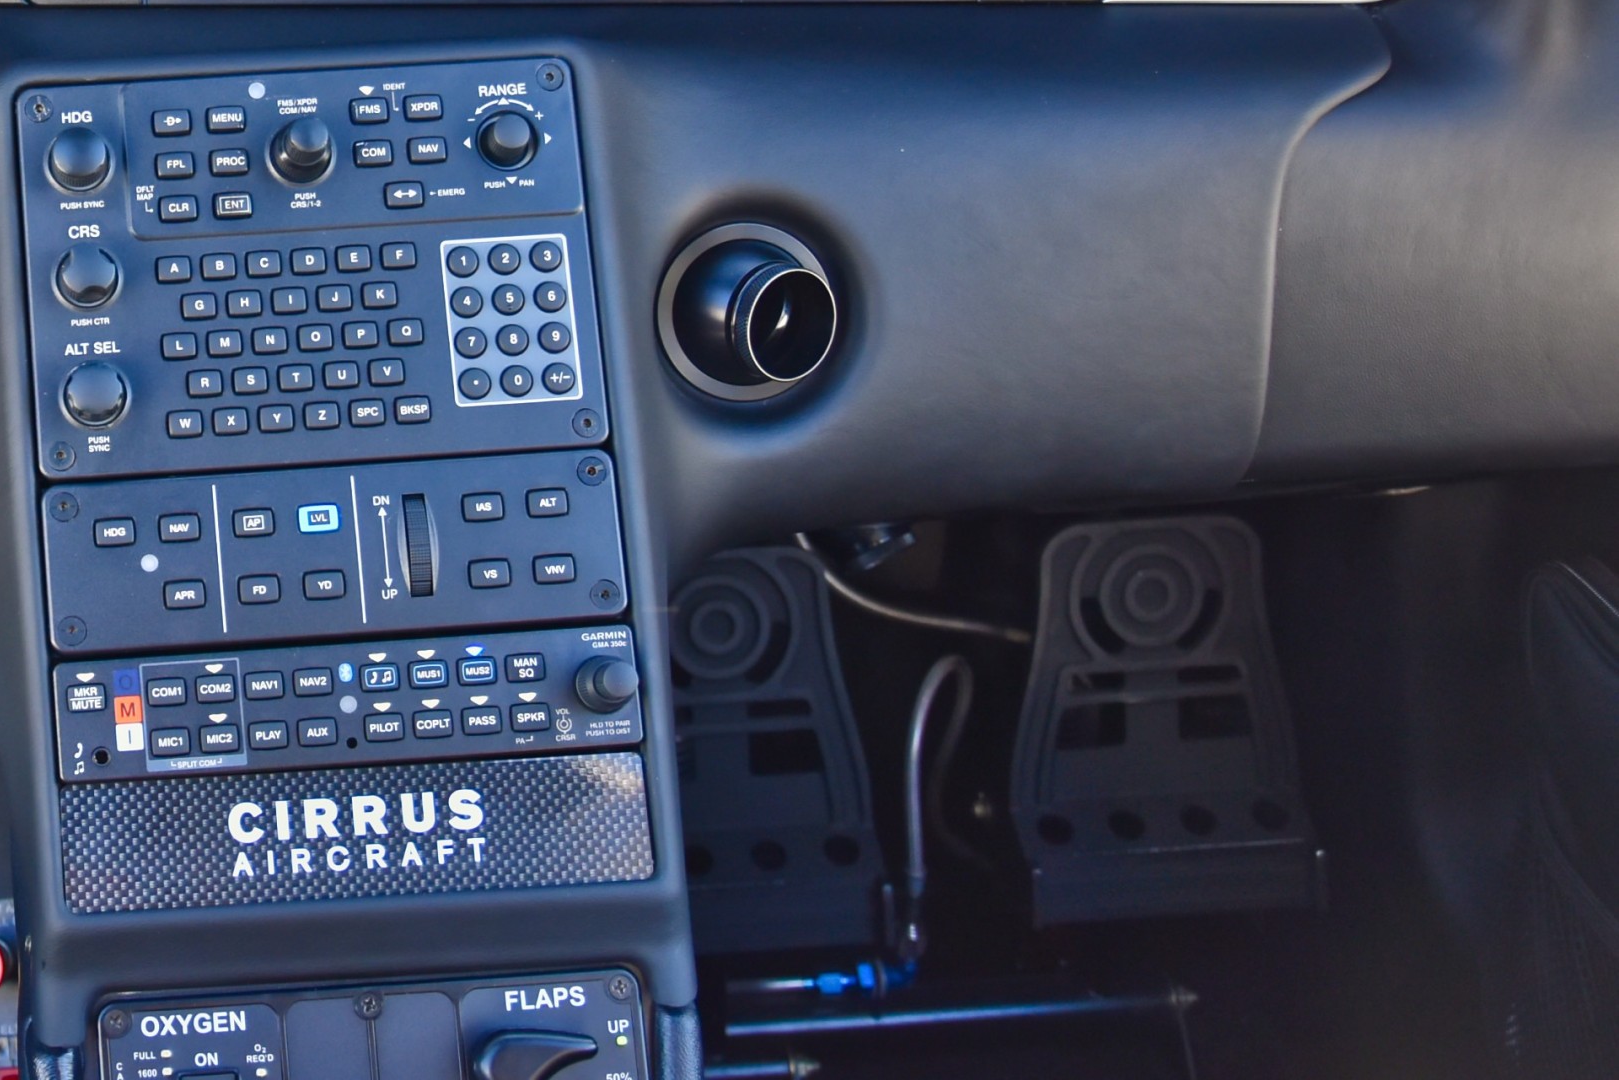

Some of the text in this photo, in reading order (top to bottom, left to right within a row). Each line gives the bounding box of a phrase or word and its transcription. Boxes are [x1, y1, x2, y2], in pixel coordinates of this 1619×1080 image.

[478, 83, 527, 98] RANGE
[410, 101, 438, 112] XPDR
[61, 110, 93, 124] HDG
[211, 112, 243, 123] MENU
[216, 156, 245, 167] PROC
[68, 224, 100, 239] CRS
[64, 341, 121, 356] ALT SEL
[400, 404, 428, 415] BKSP
[103, 527, 126, 537] HDG
[545, 565, 566, 575] VNV
[581, 630, 626, 641] GARMIN
[299, 677, 327, 687] NAV2
[151, 687, 182, 698] COM1
[199, 683, 231, 694] COM2
[468, 715, 496, 726] PASS
[517, 711, 545, 723] SPKR
[369, 722, 399, 733] PILOT
[416, 718, 450, 730] COPLT
[206, 734, 233, 744] MIC2
[228, 788, 484, 844] CIRRUS
[232, 837, 486, 877] AIRCRAFT
[504, 985, 586, 1012] FLAPS
[140, 1010, 247, 1037] OXYGEN
[607, 1019, 630, 1034] UP
[194, 1052, 219, 1067] ON
